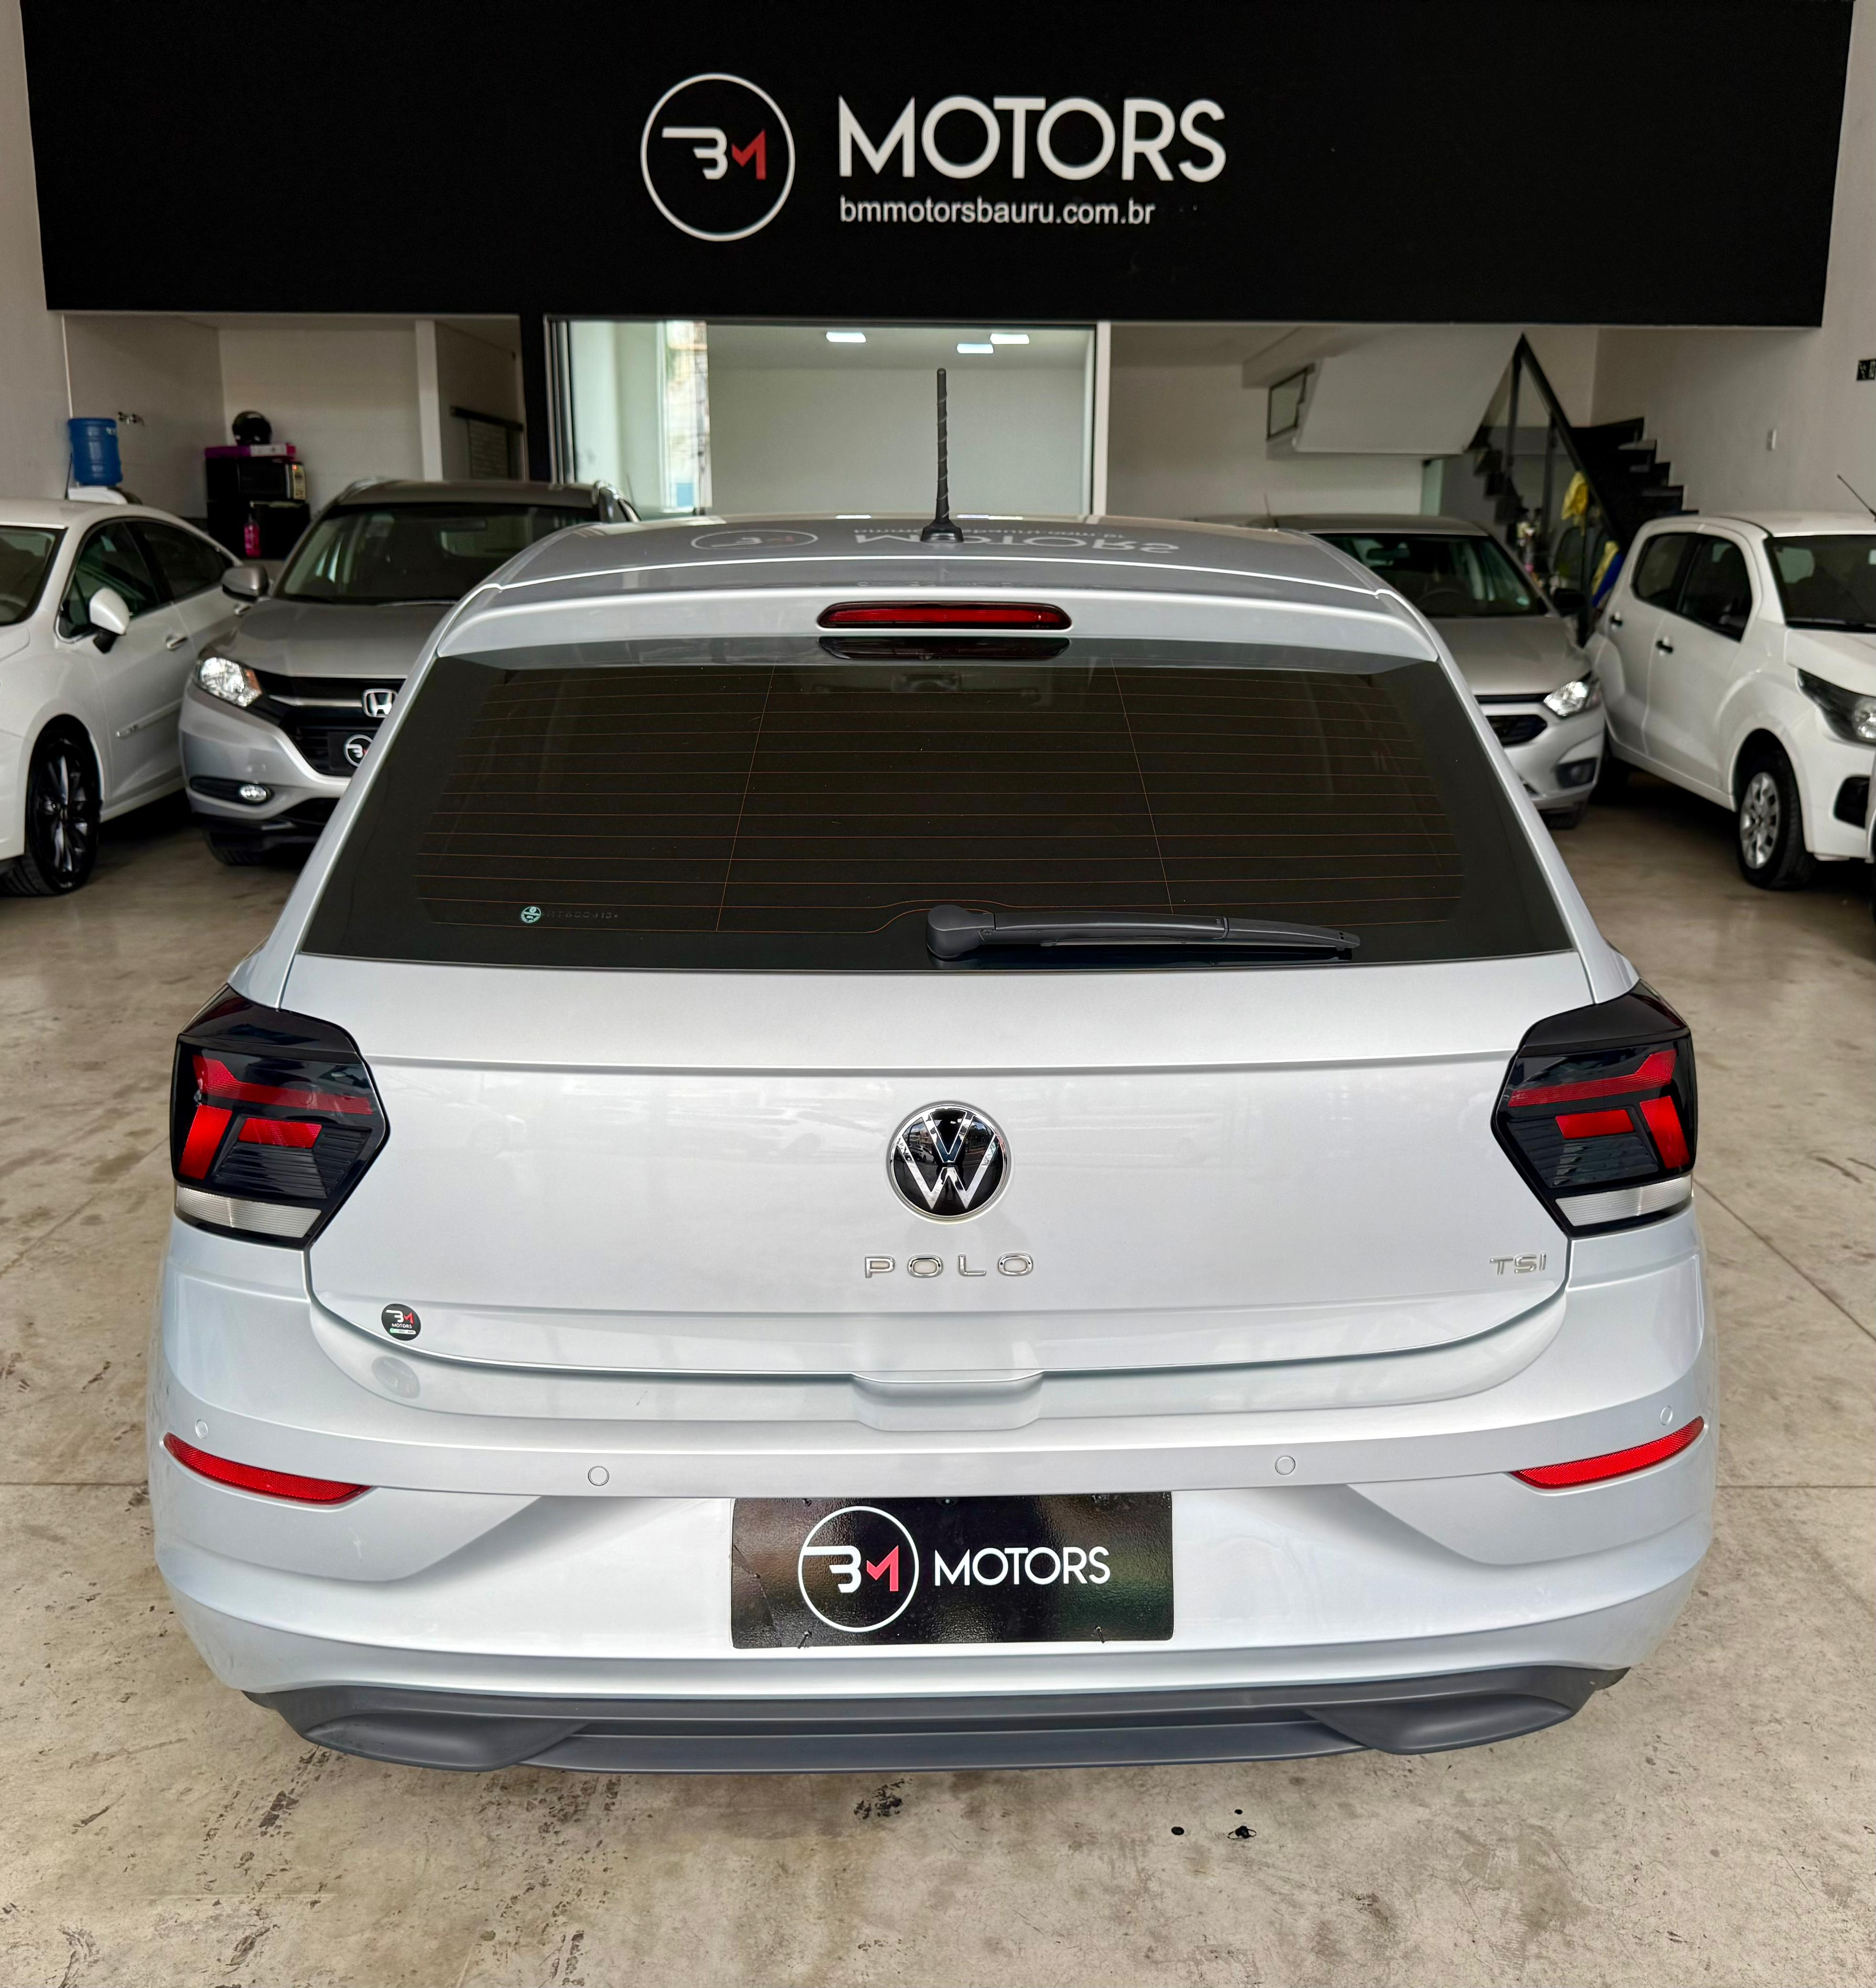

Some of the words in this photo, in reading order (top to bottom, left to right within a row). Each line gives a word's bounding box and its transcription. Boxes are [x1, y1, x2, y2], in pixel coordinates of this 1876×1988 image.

[661, 126, 765, 180] BM
[838, 96, 1227, 183] MOTORS
[840, 196, 1156, 225] bmmotorsbauru.com.br
[346, 743, 367, 758] B
[896, 1109, 996, 1210] VW
[864, 1253, 1034, 1279] POLO
[1489, 1252, 1547, 1275] TSI
[803, 1545, 899, 1593] BM
[934, 1545, 1111, 1586] MOTORS
